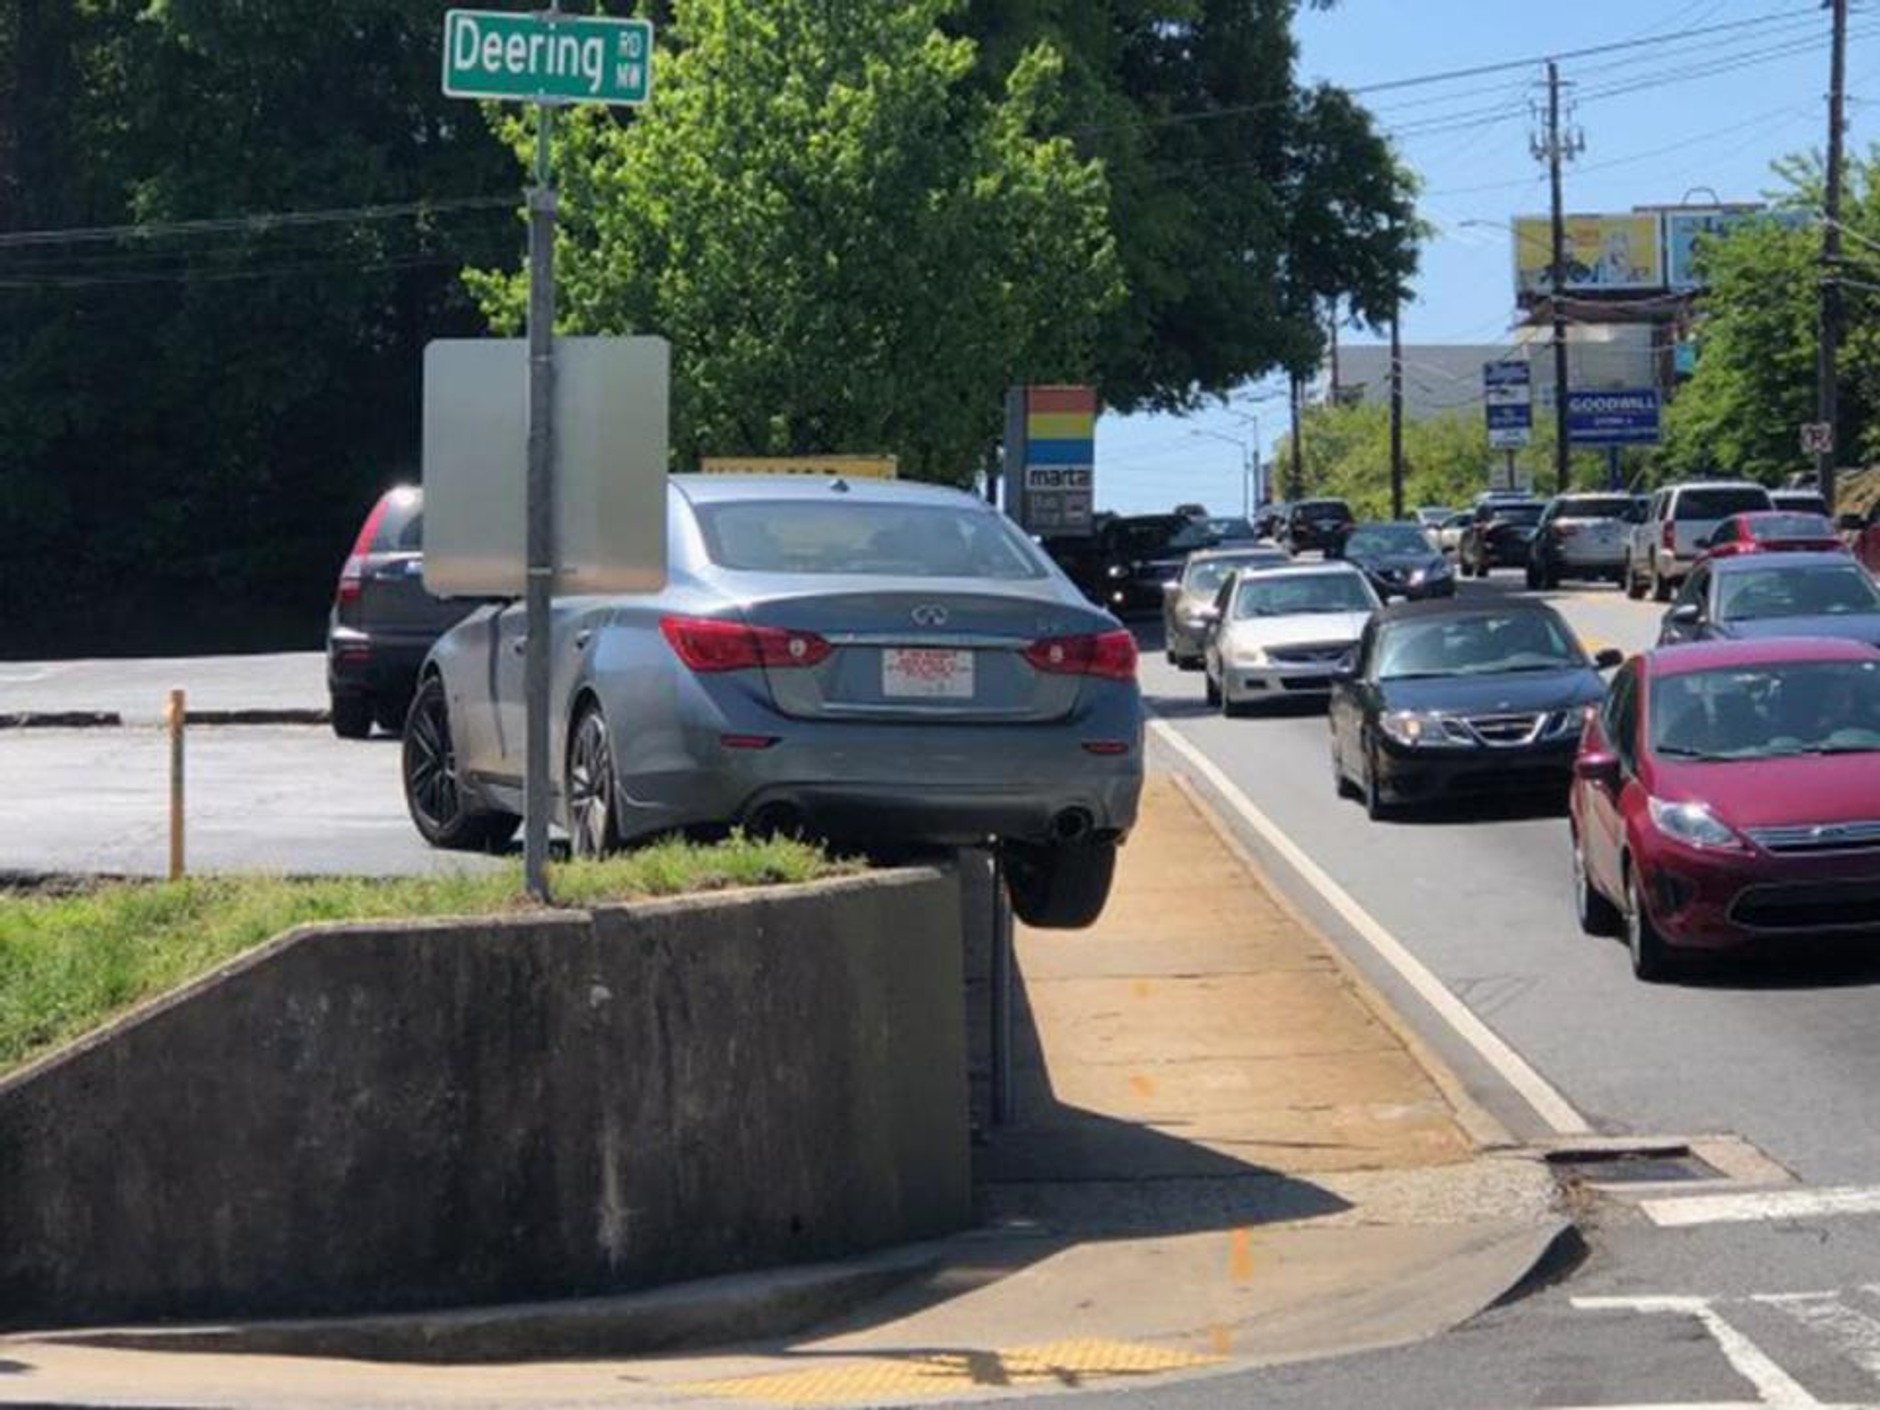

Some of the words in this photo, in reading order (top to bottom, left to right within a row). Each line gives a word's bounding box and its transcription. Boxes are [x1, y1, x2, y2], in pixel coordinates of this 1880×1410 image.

[455, 17, 604, 94] Deering
[618, 31, 642, 58] RD
[1569, 396, 1655, 412] GOODWILL
[1030, 468, 1089, 487] marta
